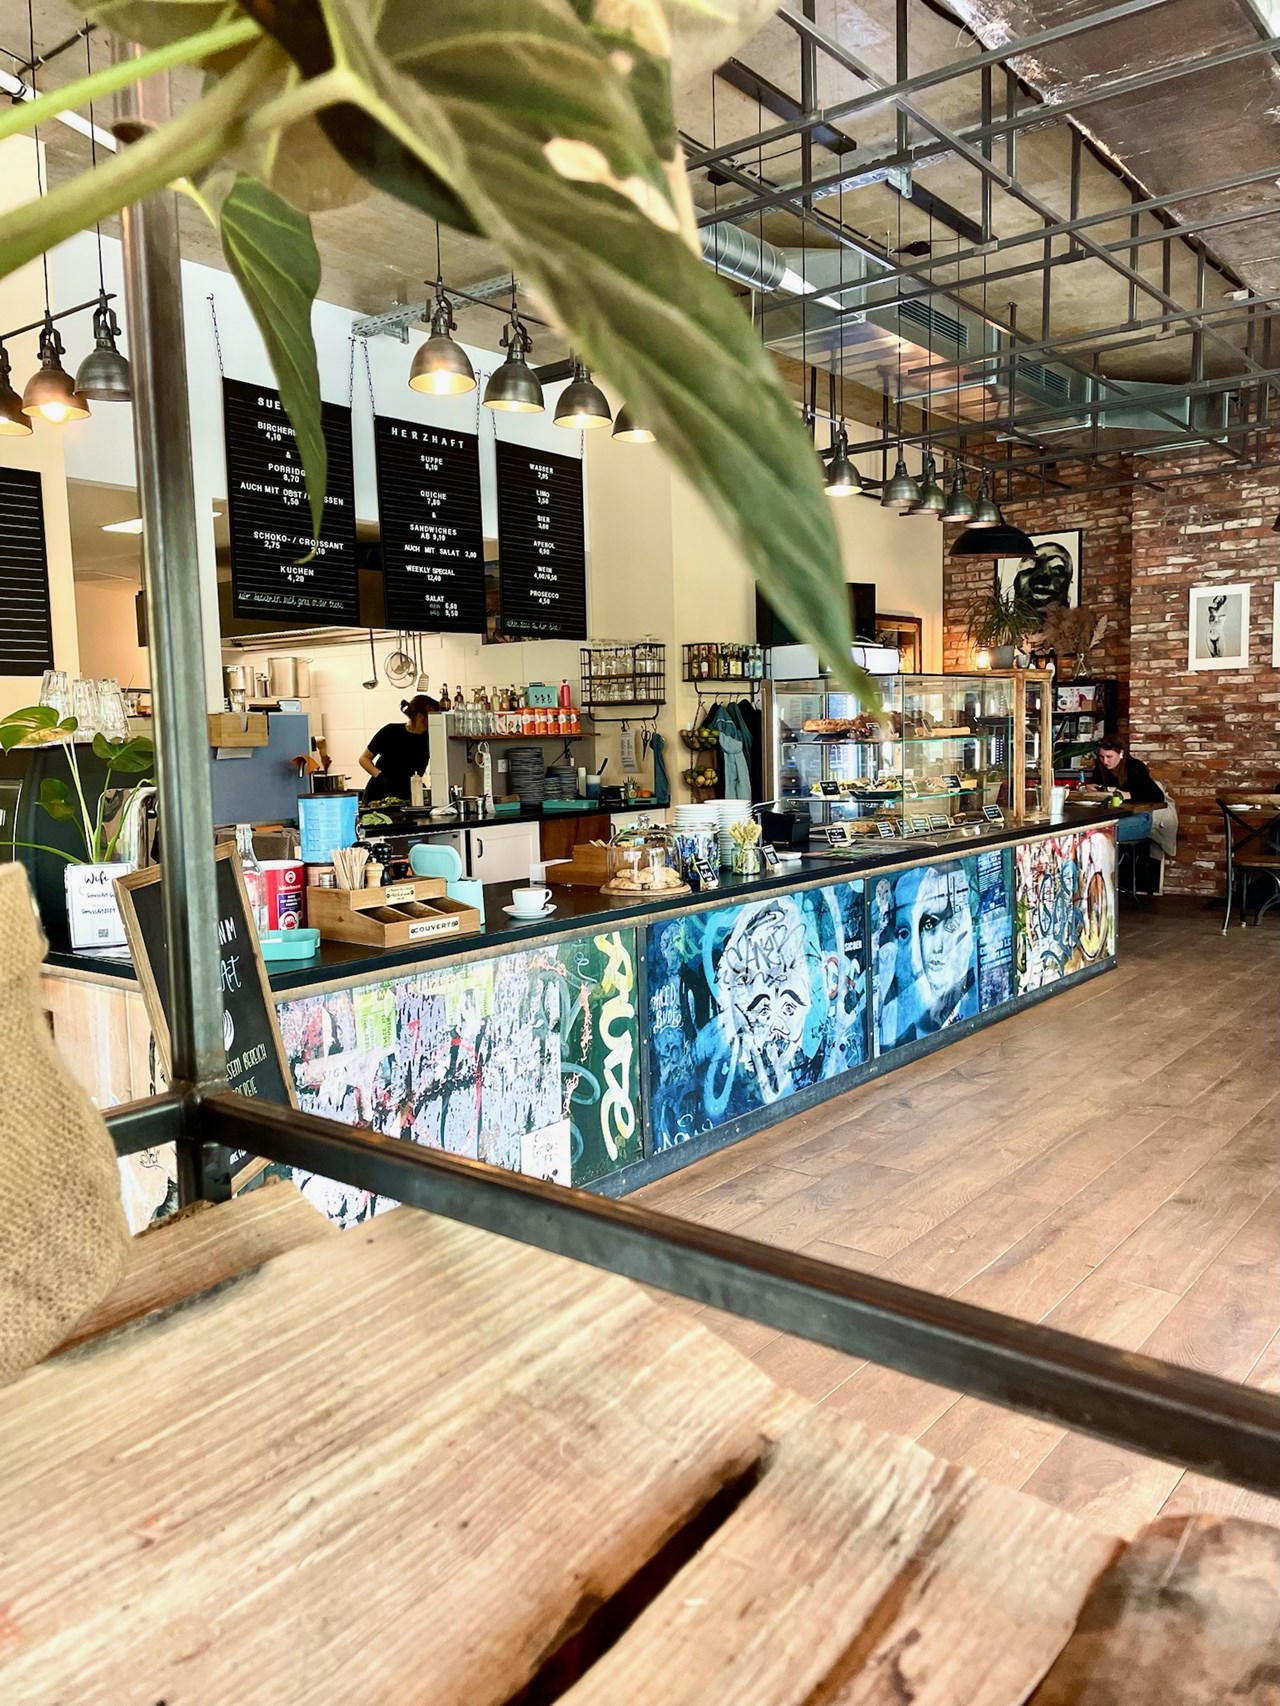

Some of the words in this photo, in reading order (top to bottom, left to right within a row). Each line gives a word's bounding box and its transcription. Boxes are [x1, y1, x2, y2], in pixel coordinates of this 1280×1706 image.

[392, 427, 464, 448] HERZHAFT
[421, 455, 442, 466] SUPPE
[530, 464, 553, 475] WASSER
[241, 482, 262, 492] AUCH
[265, 486, 279, 494] MIT
[283, 489, 302, 500] OBST
[420, 490, 446, 500] QUICHE
[537, 515, 550, 524] BIER
[410, 524, 457, 536] SANDWICHES
[299, 538, 343, 551] CROISSANT
[534, 541, 555, 550] APEROL
[440, 548, 459, 556] SALAT
[281, 566, 314, 577] KUCHEN
[406, 565, 430, 573] WEEKLY
[431, 568, 455, 577] SPECIAL
[538, 566, 552, 574] WEIN
[530, 590, 559, 600] PROSECCO
